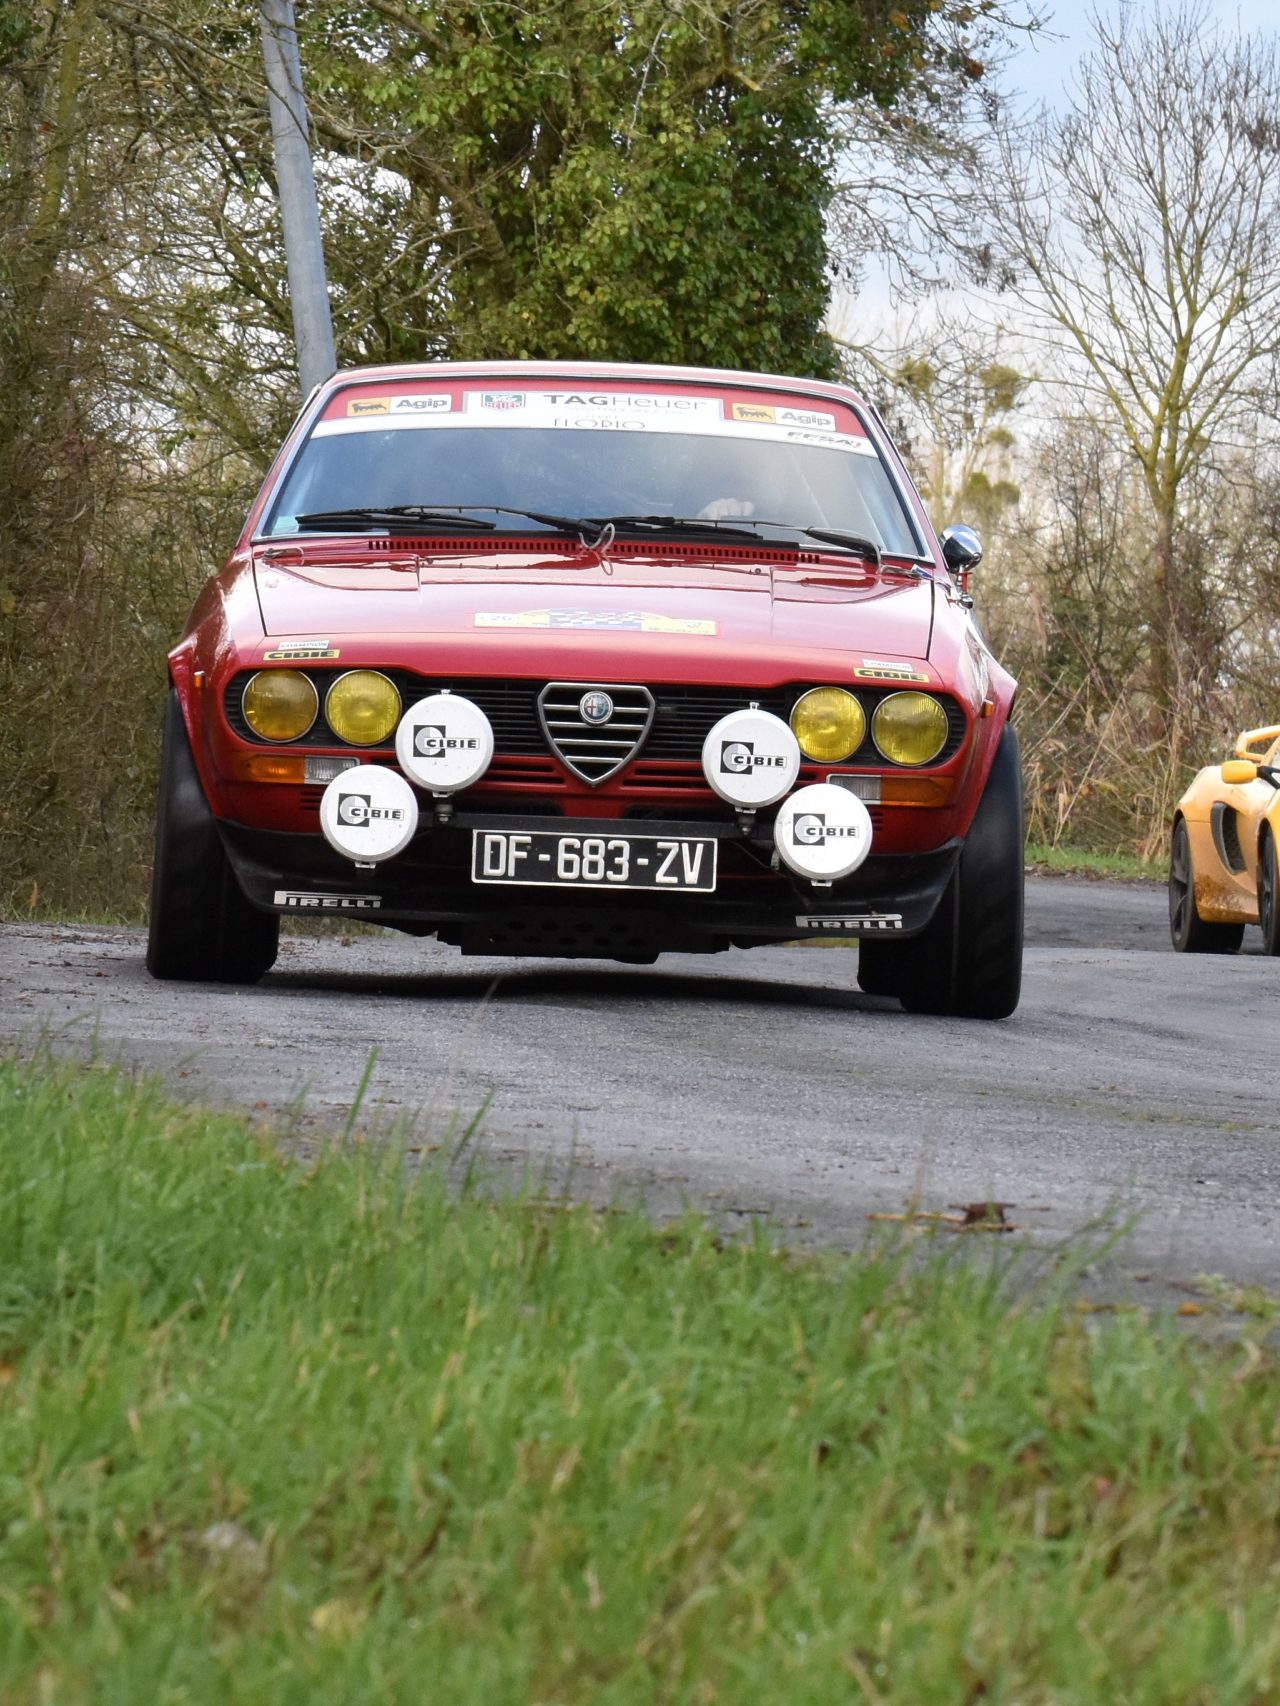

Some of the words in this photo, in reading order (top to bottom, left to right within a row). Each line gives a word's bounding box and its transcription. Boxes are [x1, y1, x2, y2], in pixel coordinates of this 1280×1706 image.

[396, 398, 448, 409] Agip
[781, 411, 832, 426] Agip
[483, 834, 704, 884] DF-683-ZV
[274, 890, 382, 908] PIRELLI
[795, 914, 902, 929] PIRELLI
